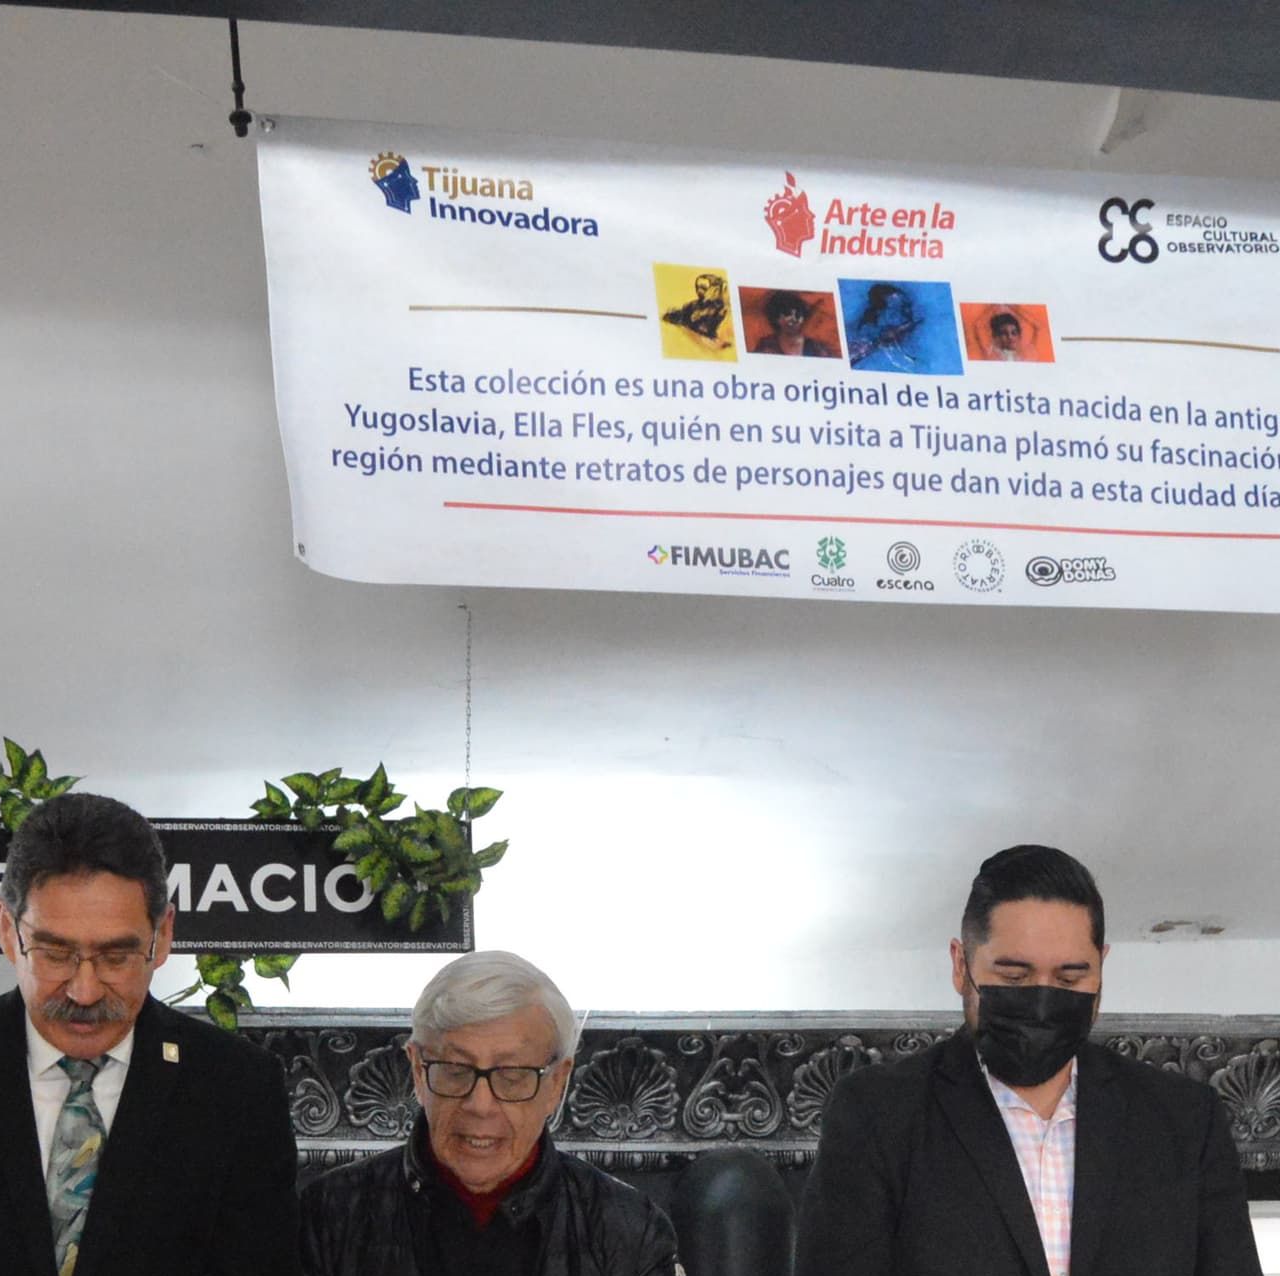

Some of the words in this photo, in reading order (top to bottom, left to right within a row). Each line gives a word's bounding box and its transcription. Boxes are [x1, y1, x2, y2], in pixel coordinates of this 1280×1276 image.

[421, 166, 533, 201] Tijuana
[429, 197, 599, 237] Innovadora
[824, 198, 887, 227] Arte
[892, 208, 926, 229] en
[931, 202, 955, 230] la
[1166, 214, 1227, 229] ESPACIO
[820, 228, 944, 259] Industria
[1167, 241, 1280, 254] OBSERVATORIO
[1203, 230, 1278, 243] CULTURAL
[409, 367, 465, 394] Esta
[475, 368, 605, 396] colección
[615, 377, 643, 397] es
[653, 379, 704, 399] una
[713, 374, 775, 401] obra
[784, 380, 888, 410] original
[896, 385, 929, 408] de
[937, 386, 959, 410] la
[968, 389, 1051, 415] artista
[1059, 395, 1142, 422] nacida
[1150, 403, 1179, 425] en
[1187, 400, 1207, 427] la
[345, 403, 505, 439] Yugoslavia,
[515, 412, 563, 438] Ella
[572, 412, 633, 443] Fles,
[642, 415, 721, 446] quién
[730, 422, 762, 443] en
[771, 424, 801, 444] su
[809, 422, 881, 447] visita
[889, 429, 904, 448] a
[910, 424, 1007, 457] Tijuana
[1016, 431, 1109, 461] plasmó
[1116, 442, 1143, 463] su
[331, 446, 423, 476] región
[432, 452, 567, 480] mediante
[575, 457, 685, 483] retratos
[693, 457, 727, 484] de
[736, 463, 884, 495] personajes
[892, 470, 942, 497] que
[951, 467, 1000, 495] dan
[1008, 470, 1062, 498] vida
[1070, 481, 1084, 499] a
[1092, 480, 1142, 503] esta
[1150, 481, 1236, 508] ciudad
[670, 545, 790, 570] FIMUBAC
[1060, 557, 1106, 572] DOMY
[876, 579, 934, 590] escena
[1063, 567, 1116, 582] DONAS
